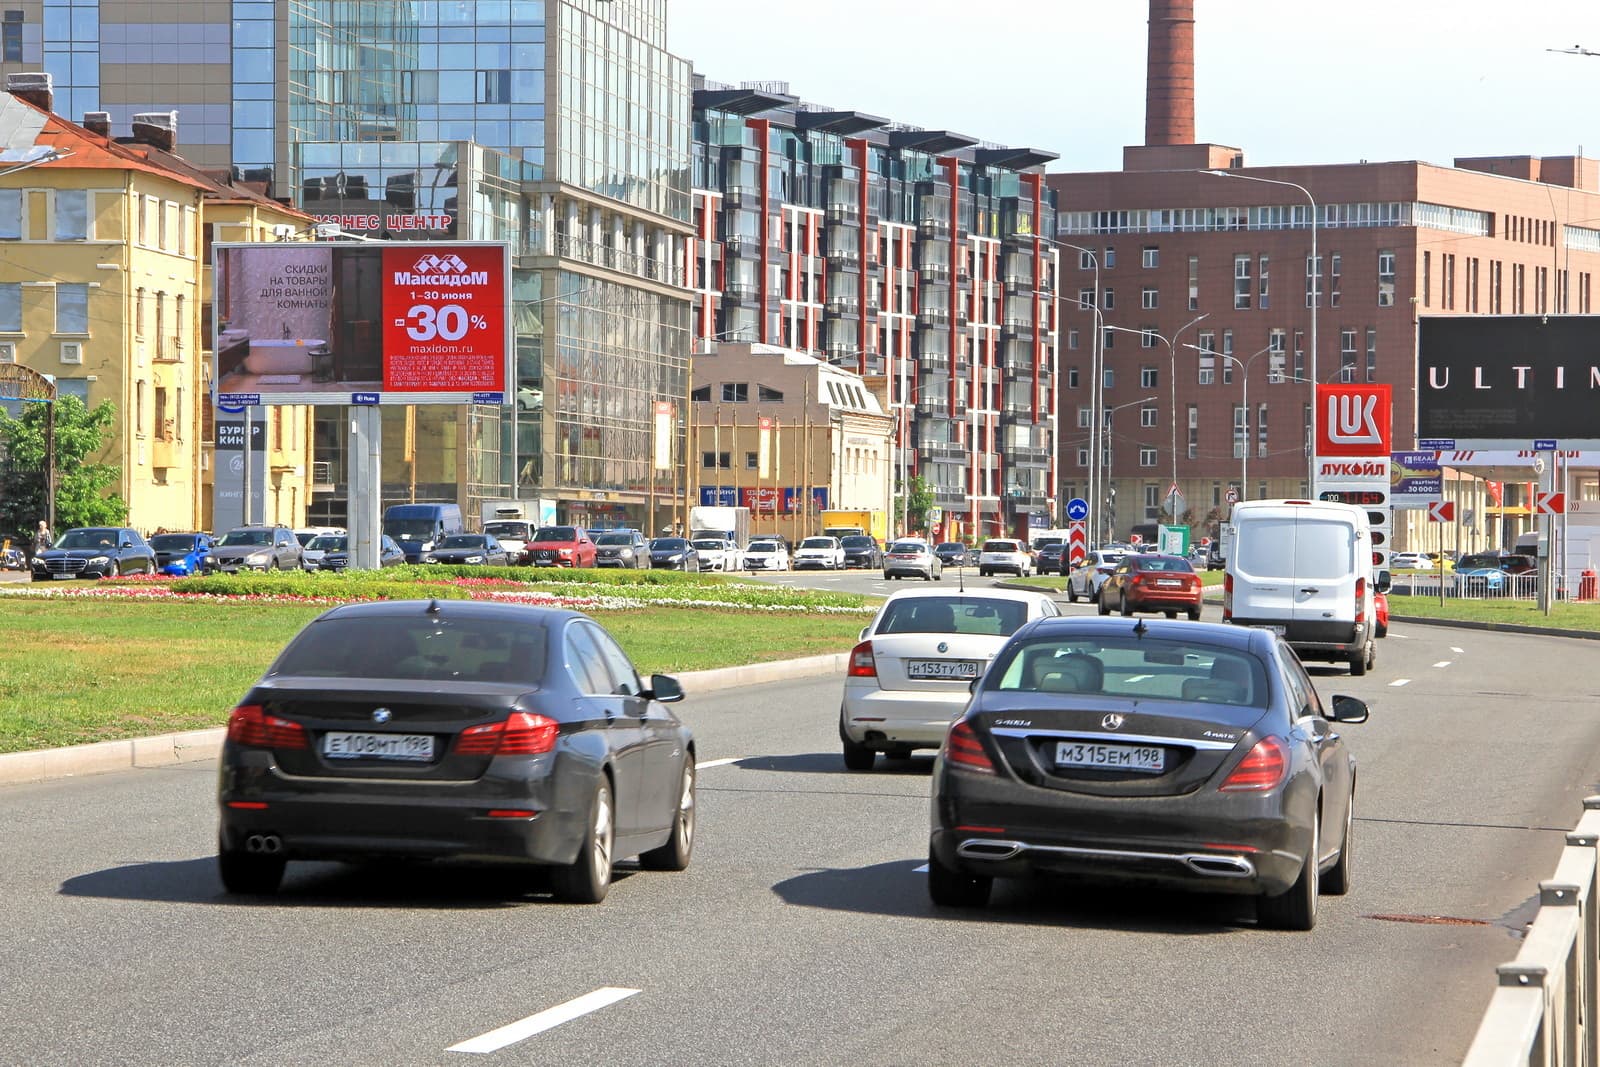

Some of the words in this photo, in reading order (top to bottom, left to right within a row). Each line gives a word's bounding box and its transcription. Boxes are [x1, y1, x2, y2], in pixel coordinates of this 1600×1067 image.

[387, 214, 452, 232] ЦЕНТР
[285, 264, 328, 275] СКИДКИ
[270, 276, 284, 285] НА
[286, 276, 328, 285] ТОВАРЫ
[260, 288, 283, 298] ДЛЯ
[284, 286, 328, 297] ВАННОЙ
[441, 292, 473, 300] июня
[277, 300, 328, 309] КОМНАТЫ
[410, 344, 473, 353] maxidom.ru
[219, 436, 244, 445] КИН
[1320, 461, 1385, 476] ЛУКОЙЛ
[913, 663, 956, 675] Н153ТУ
[957, 663, 975, 673] 178
[1061, 745, 1131, 765] М315ЕМ
[1134, 748, 1161, 763] 198
